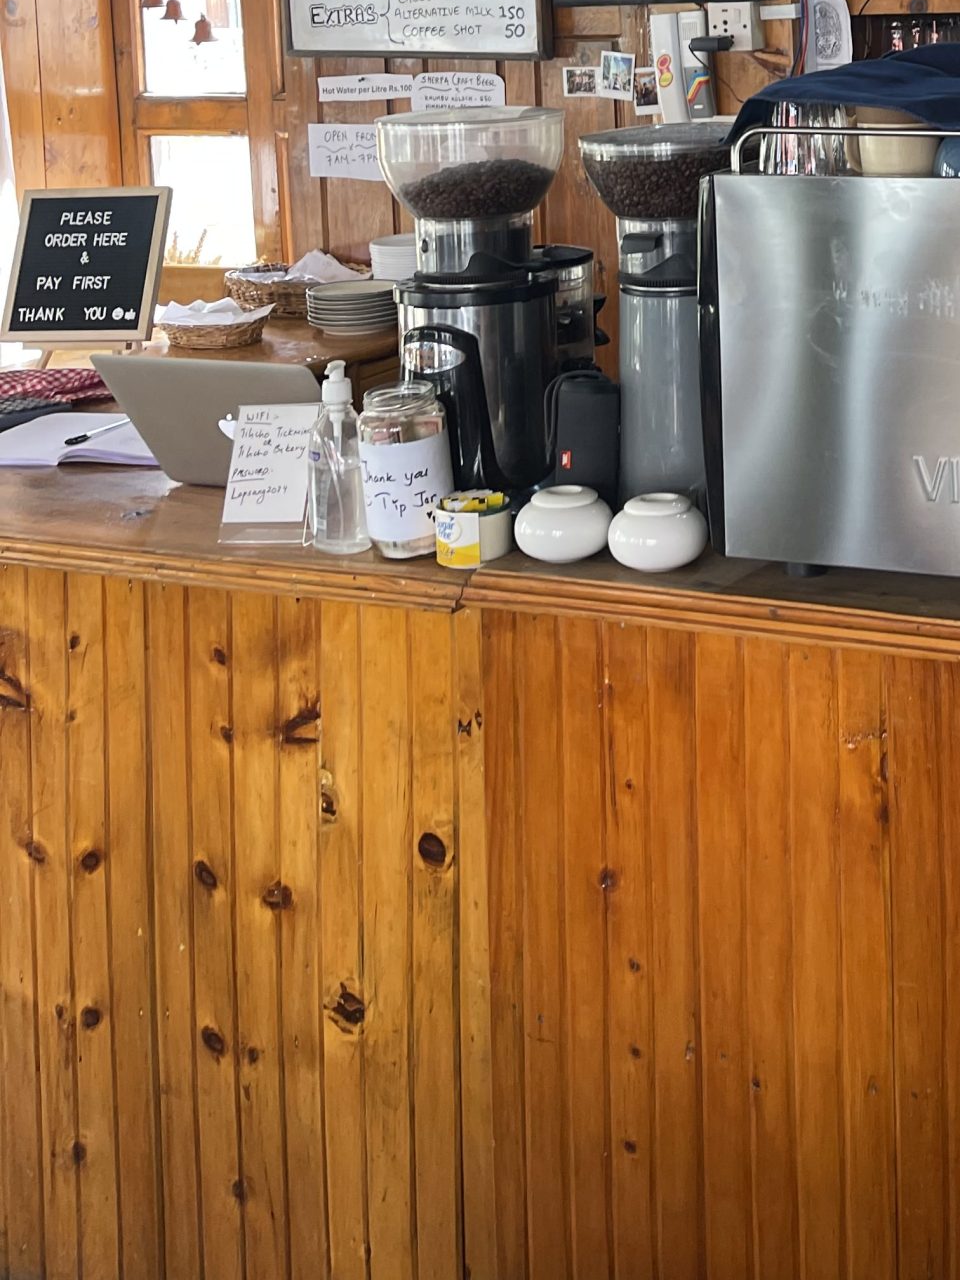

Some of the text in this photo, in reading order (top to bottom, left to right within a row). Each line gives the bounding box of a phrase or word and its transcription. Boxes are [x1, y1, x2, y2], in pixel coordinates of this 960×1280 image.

[311, 7, 378, 25] EXTRAS
[395, 6, 524, 19] ALTERNATIVE MILK 150
[402, 25, 525, 38] COFFEE SHOT 50
[337, 87, 357, 95] Water
[358, 87, 370, 95] per
[372, 85, 387, 93] Litre
[400, 84, 412, 92] 100
[324, 130, 347, 142] OPEN
[60, 211, 112, 226] PLEASE
[45, 232, 128, 247] ORDER HERE
[80, 251, 89, 264] &
[37, 276, 111, 290] PAY FIRST
[18, 307, 107, 322] THANK YOU
[246, 411, 269, 421] WIFI
[361, 460, 396, 483] Thank
[374, 490, 437, 518] Tip Jar
